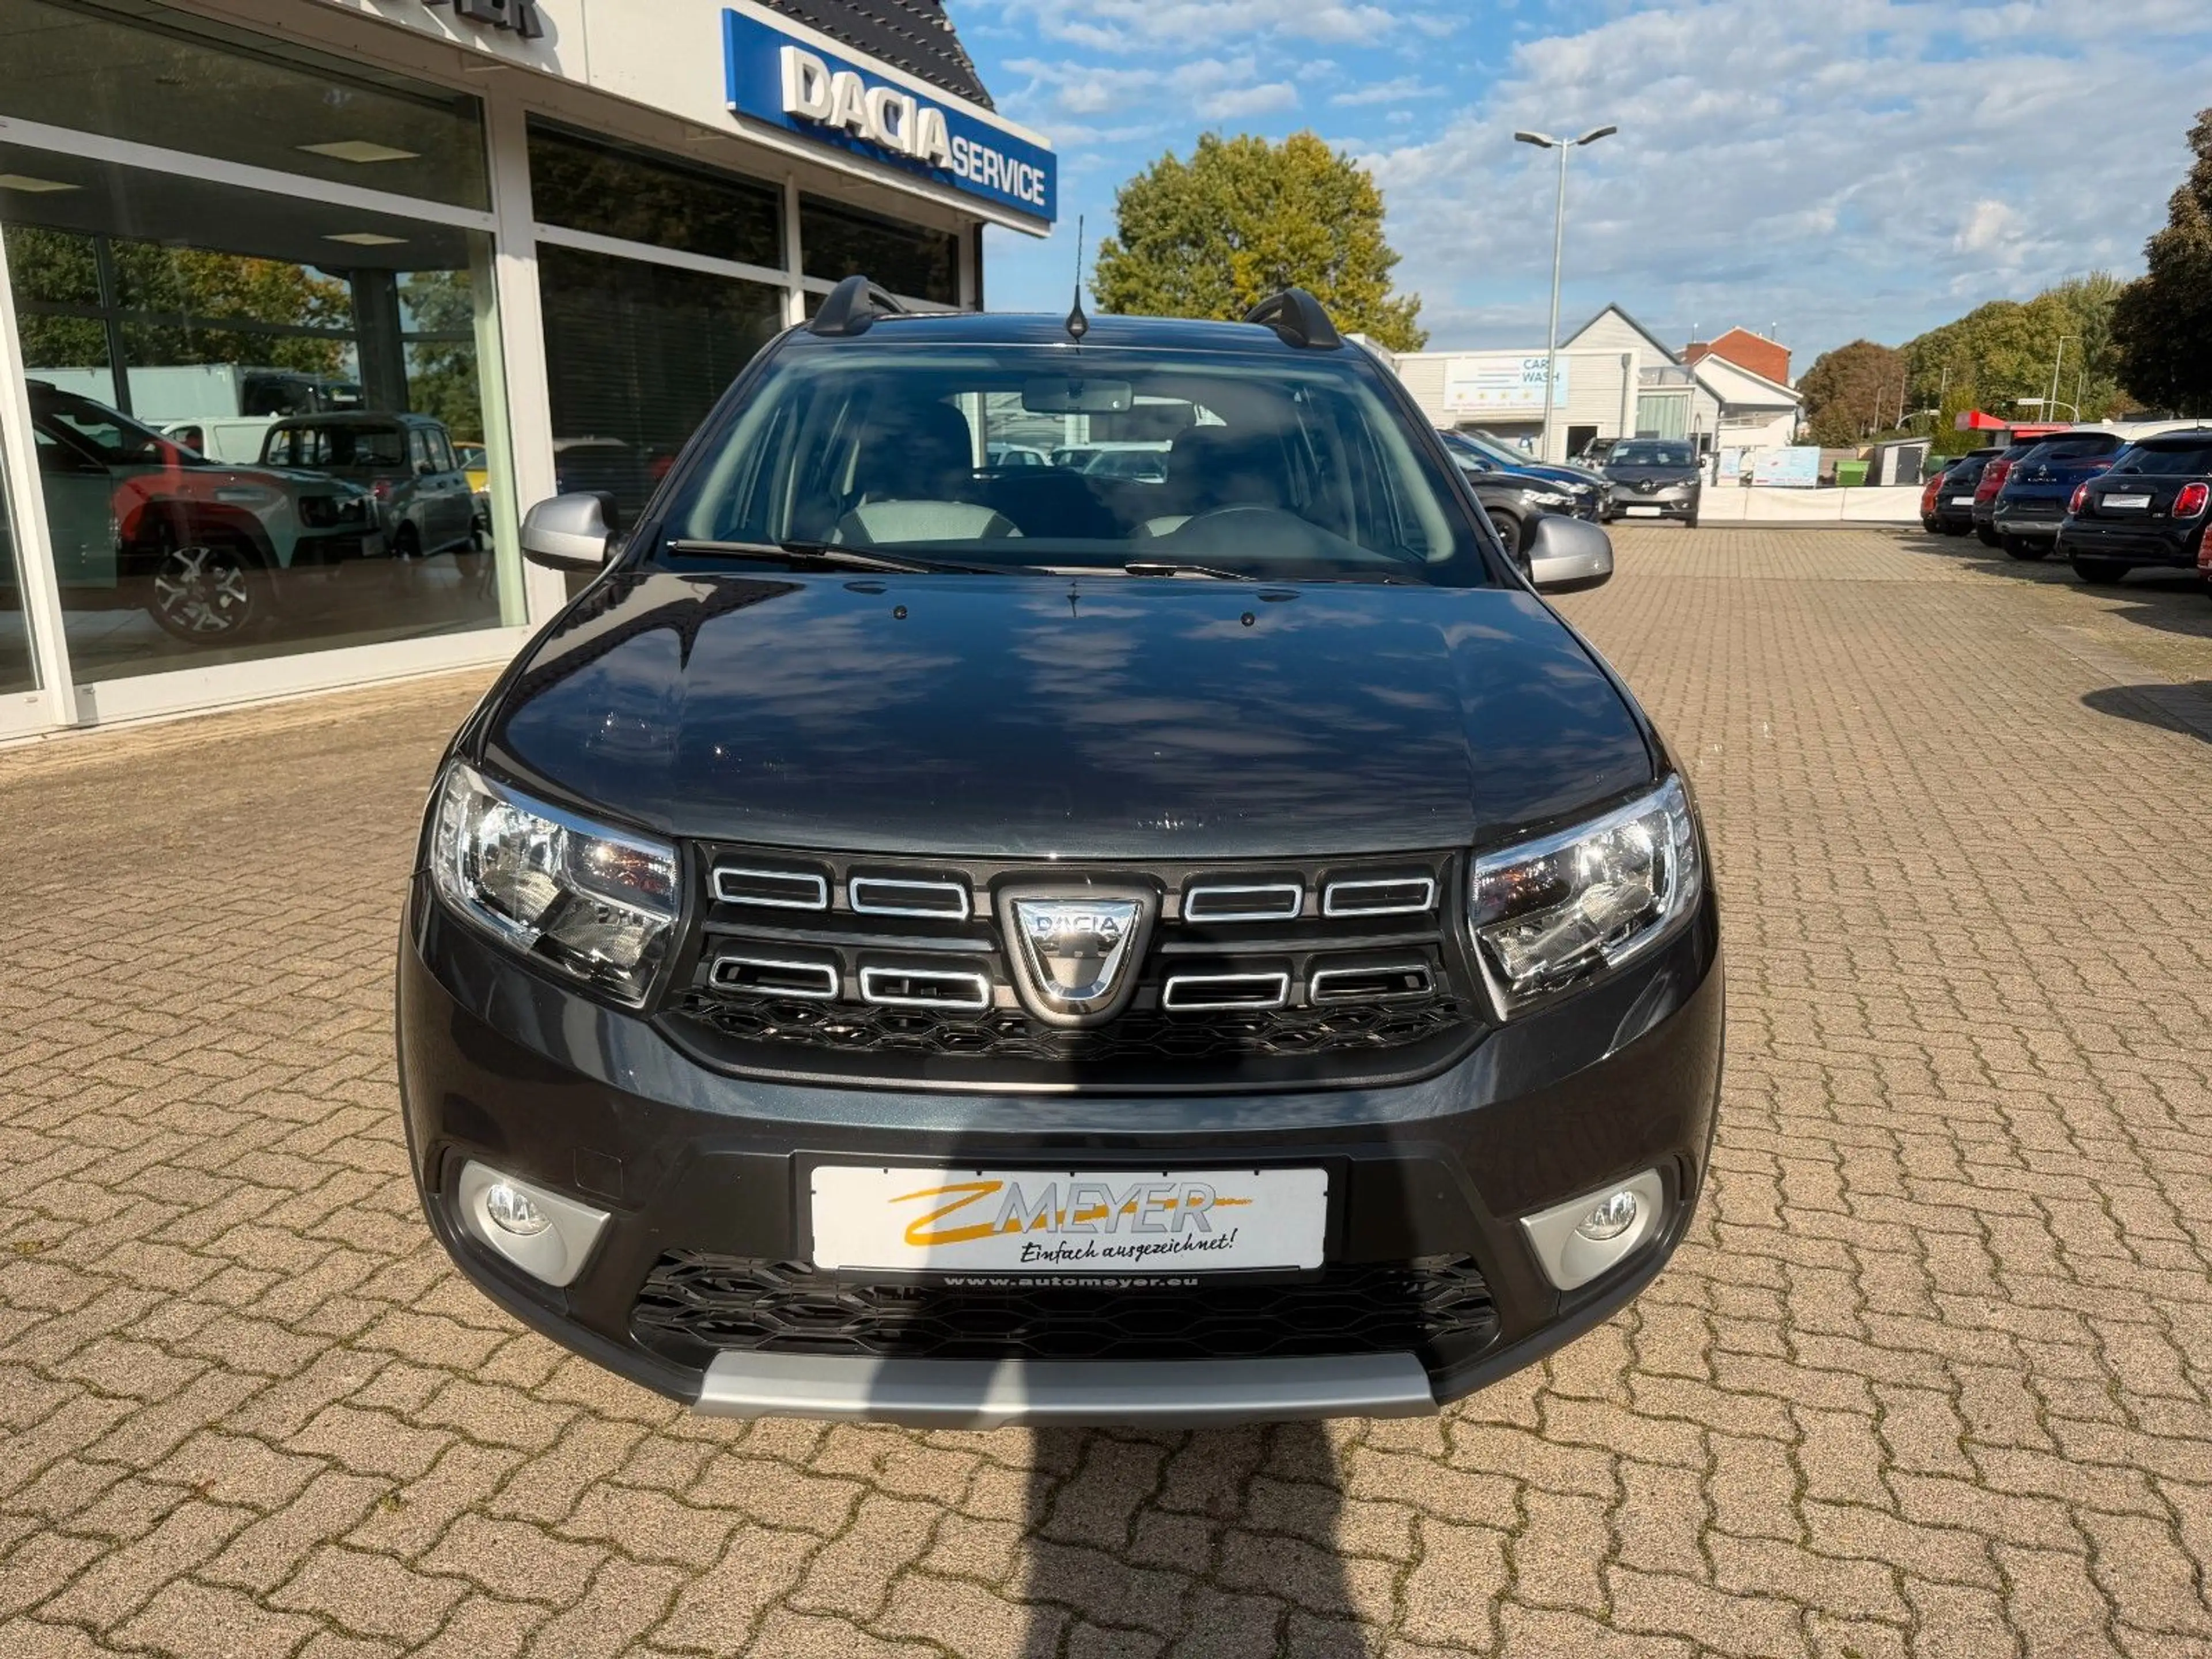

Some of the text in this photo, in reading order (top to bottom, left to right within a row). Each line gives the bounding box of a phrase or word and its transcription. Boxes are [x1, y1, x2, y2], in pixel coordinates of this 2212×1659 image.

[780, 46, 1046, 206] DACIA SERVICE
[1523, 359, 1550, 370] CAR
[1036, 916, 1119, 932] DACIA
[1020, 1228, 1238, 1264] Einfach ausgezeichnet!
[944, 1277, 1199, 1288] www.automeyer.eu
